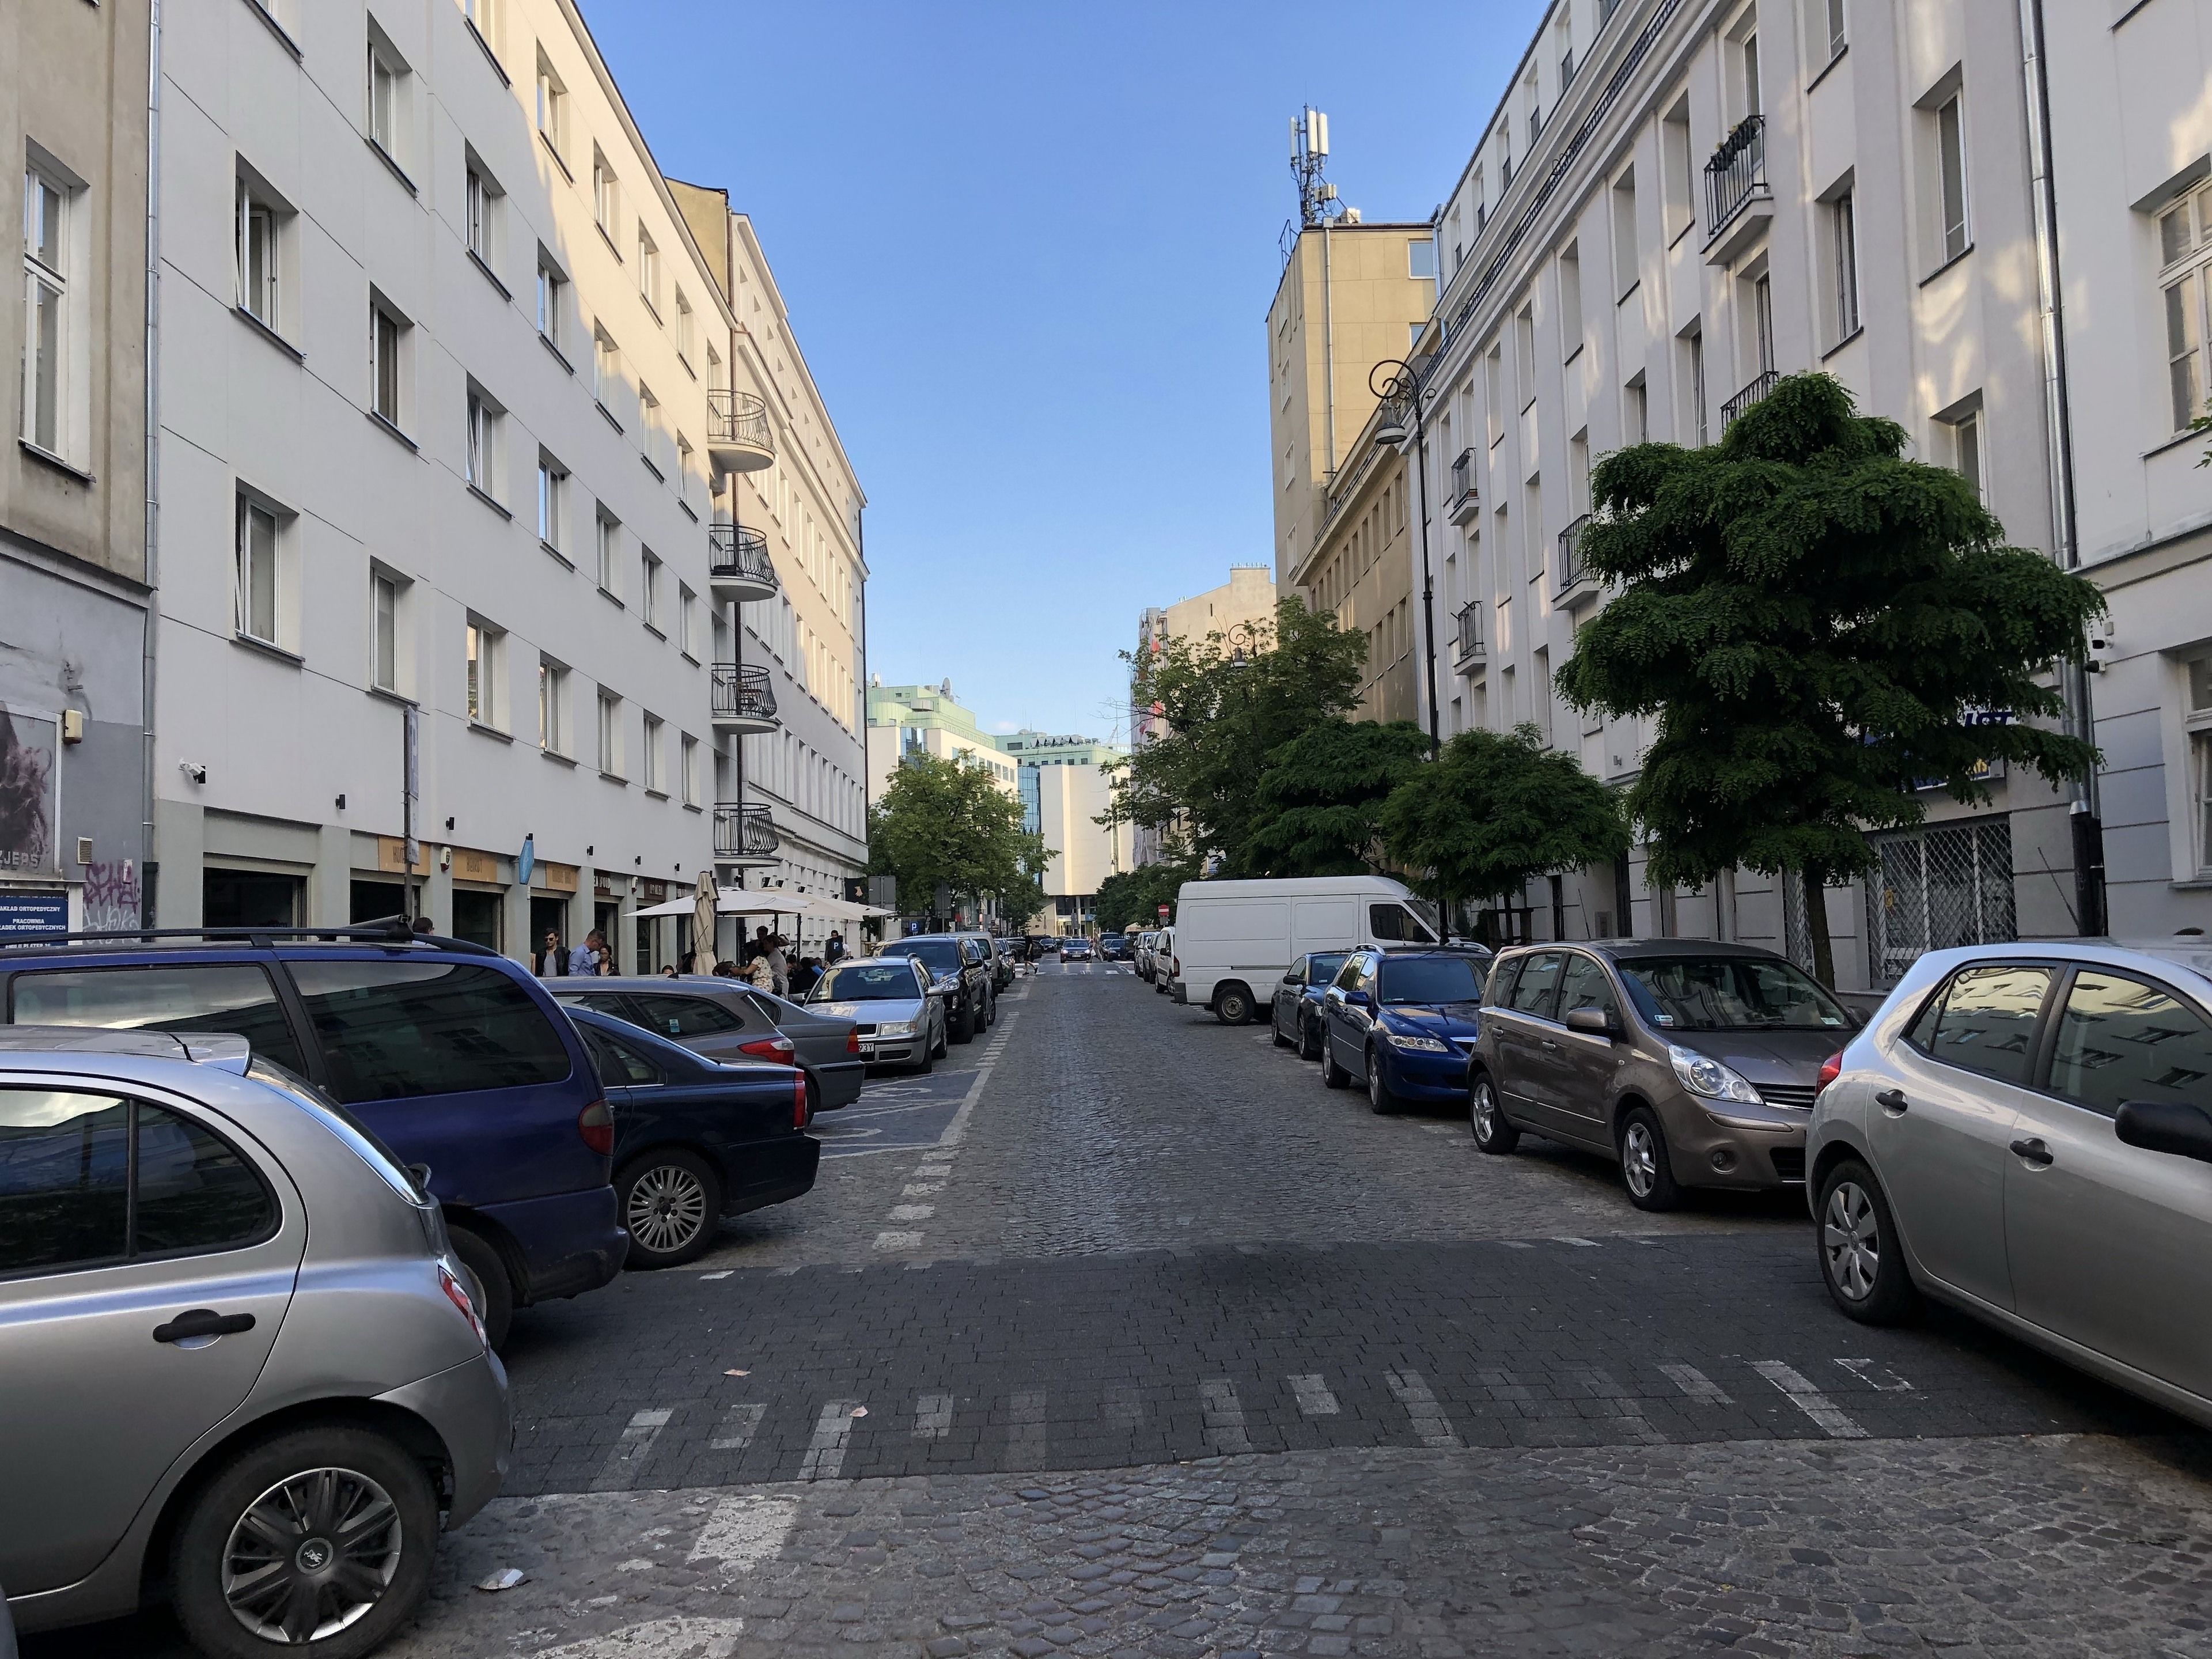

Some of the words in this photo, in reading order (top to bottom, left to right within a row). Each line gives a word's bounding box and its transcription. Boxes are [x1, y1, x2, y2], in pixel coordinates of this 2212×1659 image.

[911, 923, 917, 931] P
[833, 942, 839, 950] P
[858, 1043, 873, 1051] 93Y
